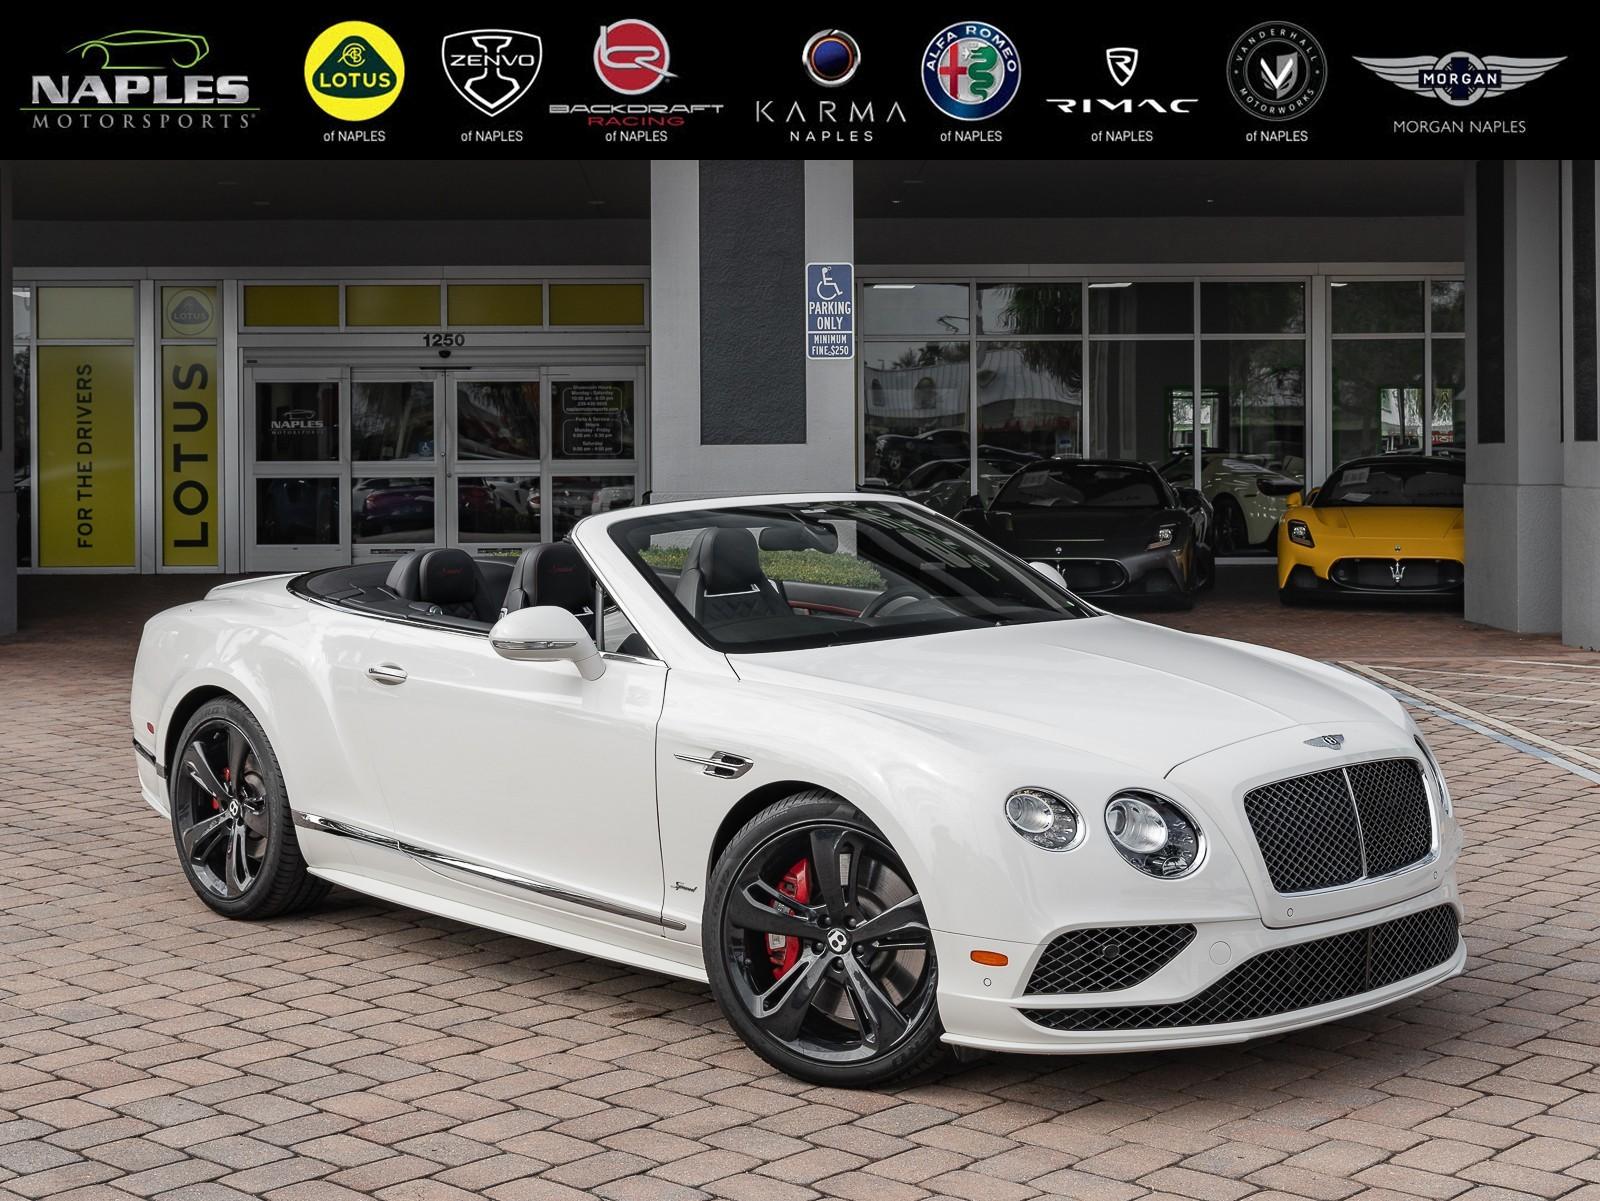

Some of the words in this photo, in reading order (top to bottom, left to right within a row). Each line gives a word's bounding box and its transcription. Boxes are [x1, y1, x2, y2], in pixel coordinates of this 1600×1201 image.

[809, 302, 851, 315] PARKING
[173, 312, 208, 321] LOTUS
[817, 317, 843, 330] ONLY
[422, 333, 465, 347] 1250
[814, 334, 846, 344] MINIMUM
[812, 345, 828, 355] FINE
[830, 345, 849, 356] $250
[76, 364, 92, 455] DRIVERS
[271, 420, 324, 429] NAPLES
[172, 363, 209, 548] LOTUS
[77, 462, 93, 502] THE
[77, 508, 93, 548] FOR
